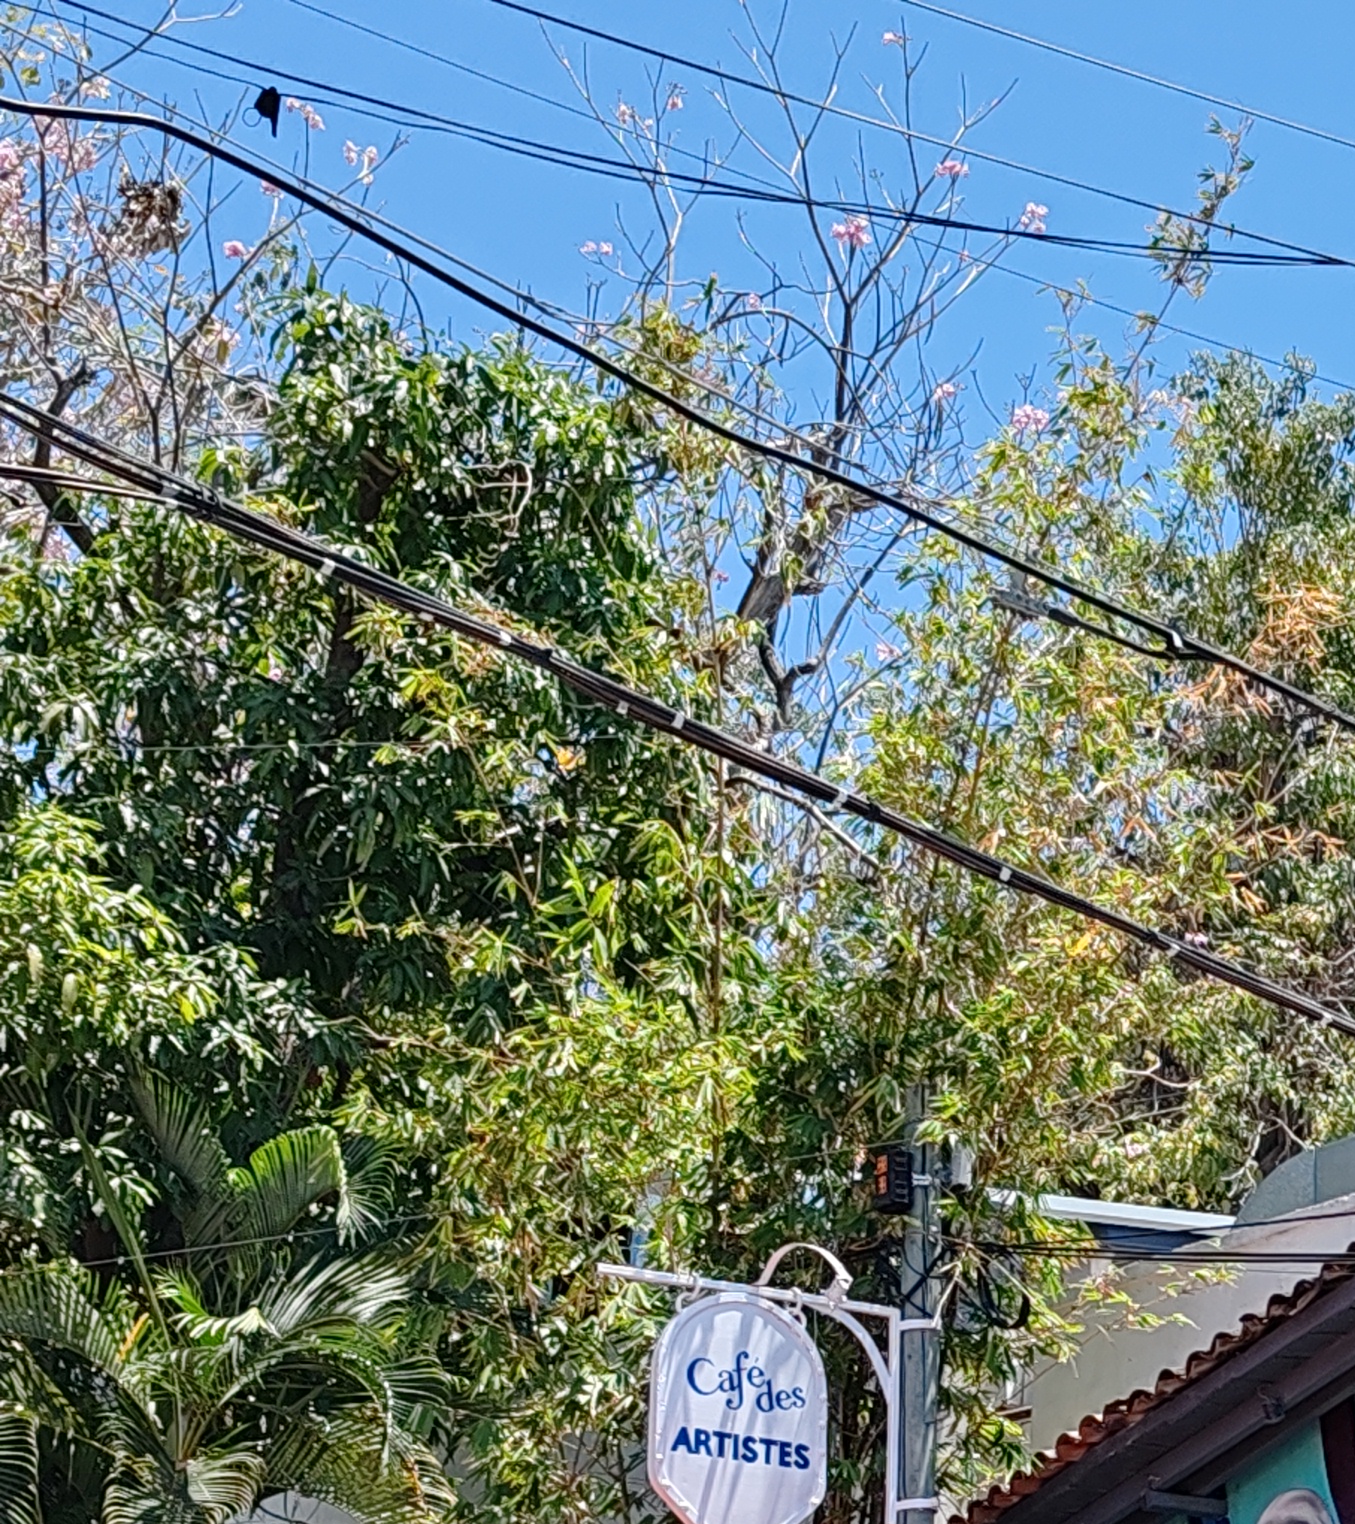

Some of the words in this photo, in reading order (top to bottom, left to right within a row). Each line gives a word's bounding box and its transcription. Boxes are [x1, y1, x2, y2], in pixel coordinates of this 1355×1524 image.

[686, 1350, 765, 1411] Café
[756, 1376, 806, 1413] des
[671, 1426, 811, 1470] ARTISTES
